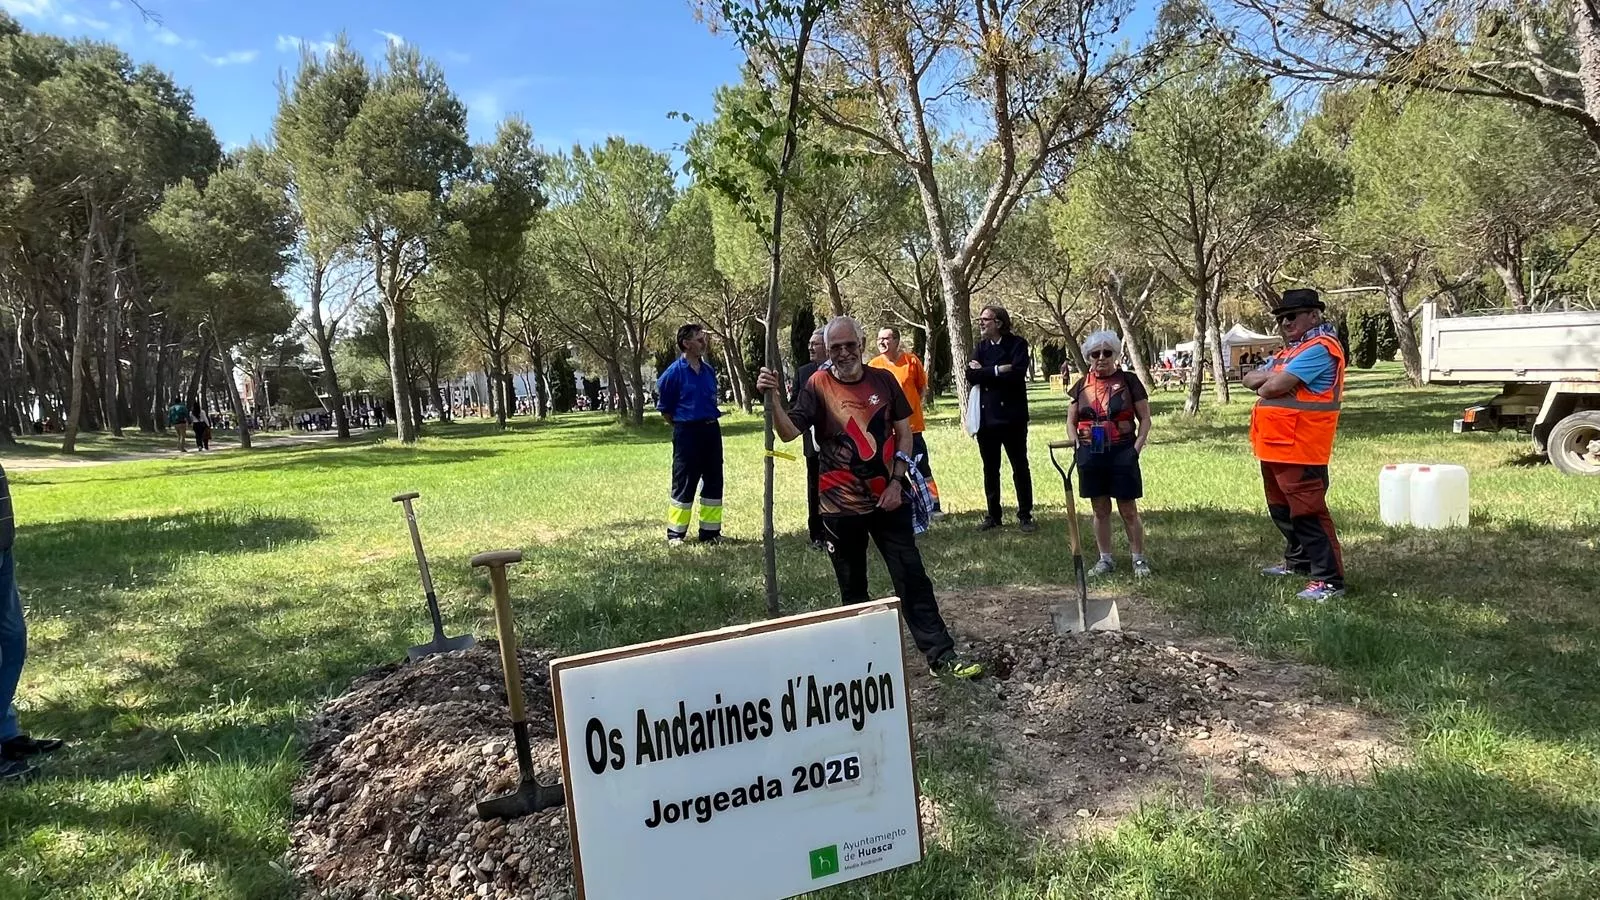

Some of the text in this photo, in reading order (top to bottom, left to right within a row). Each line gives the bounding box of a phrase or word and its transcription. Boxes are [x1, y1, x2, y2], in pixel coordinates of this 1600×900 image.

[586, 717, 625, 775] Os
[635, 694, 773, 765] Andarines
[644, 756, 860, 828] Jorgeada 2026
[843, 828, 906, 850] Ayuntamiento
[844, 843, 893, 862] de Huesca
